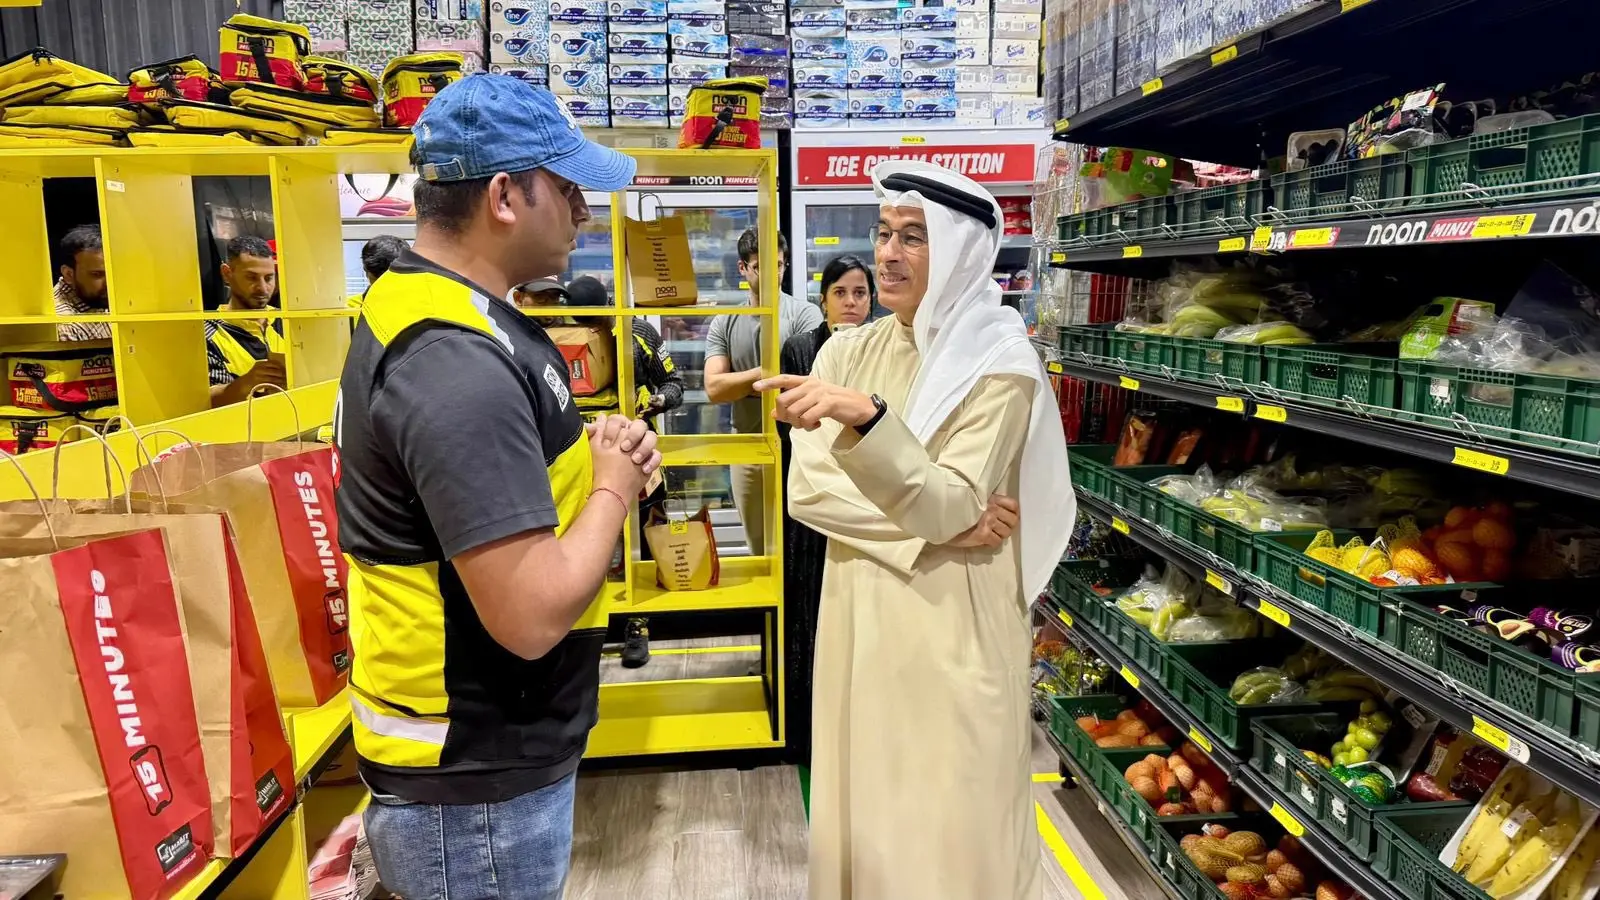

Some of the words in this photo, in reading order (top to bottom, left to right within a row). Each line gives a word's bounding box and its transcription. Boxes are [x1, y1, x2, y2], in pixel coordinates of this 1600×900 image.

[505, 11, 521, 20] fine
[505, 41, 521, 50] fine
[564, 41, 579, 50] fine
[236, 61, 249, 77] 15
[564, 72, 579, 81] fine
[826, 155, 860, 177] ICE
[931, 153, 1006, 175] STATION
[689, 176, 723, 185] noon
[1364, 220, 1428, 246] noon
[1430, 221, 1477, 237] MINU
[14, 388, 24, 402] 15
[294, 471, 340, 588] MINUTES
[328, 597, 347, 626] 15
[136, 760, 164, 803] 15
